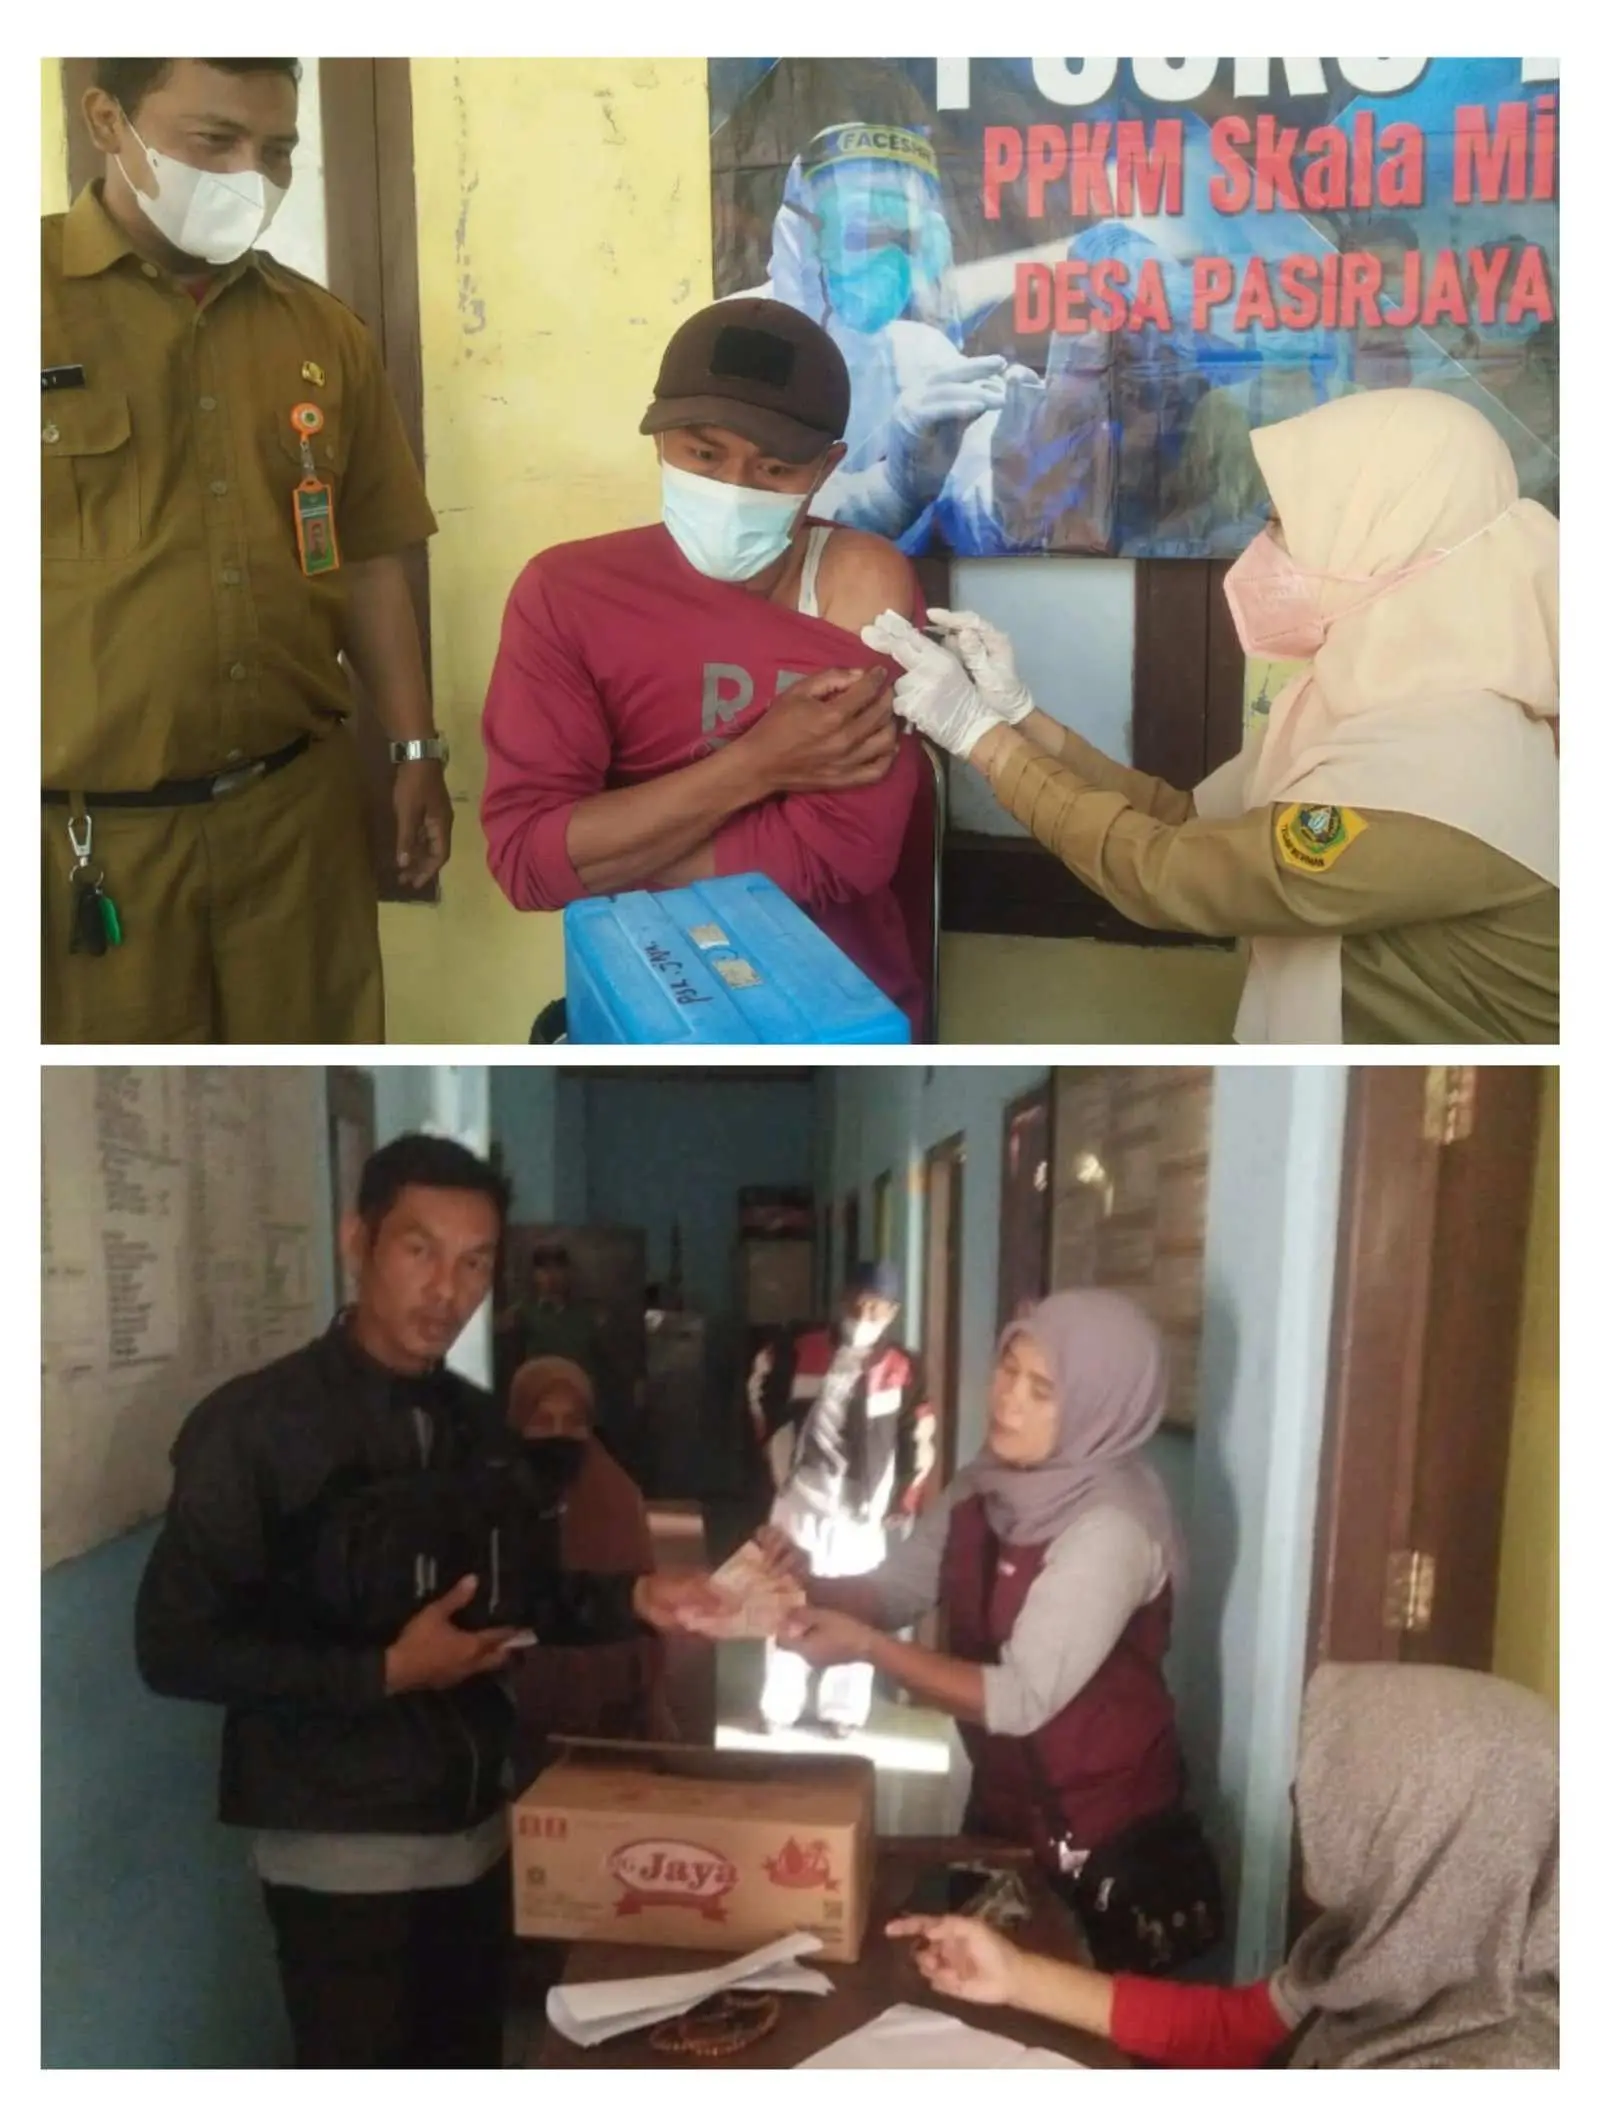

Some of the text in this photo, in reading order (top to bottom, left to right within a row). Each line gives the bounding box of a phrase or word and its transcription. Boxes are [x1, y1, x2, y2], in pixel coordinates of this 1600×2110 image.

[983, 119, 1183, 219] PPKM
[1208, 111, 1424, 213] Skala
[1014, 245, 1556, 334] DESA PASIRJAYA
[639, 1851, 739, 1891] Jaya
